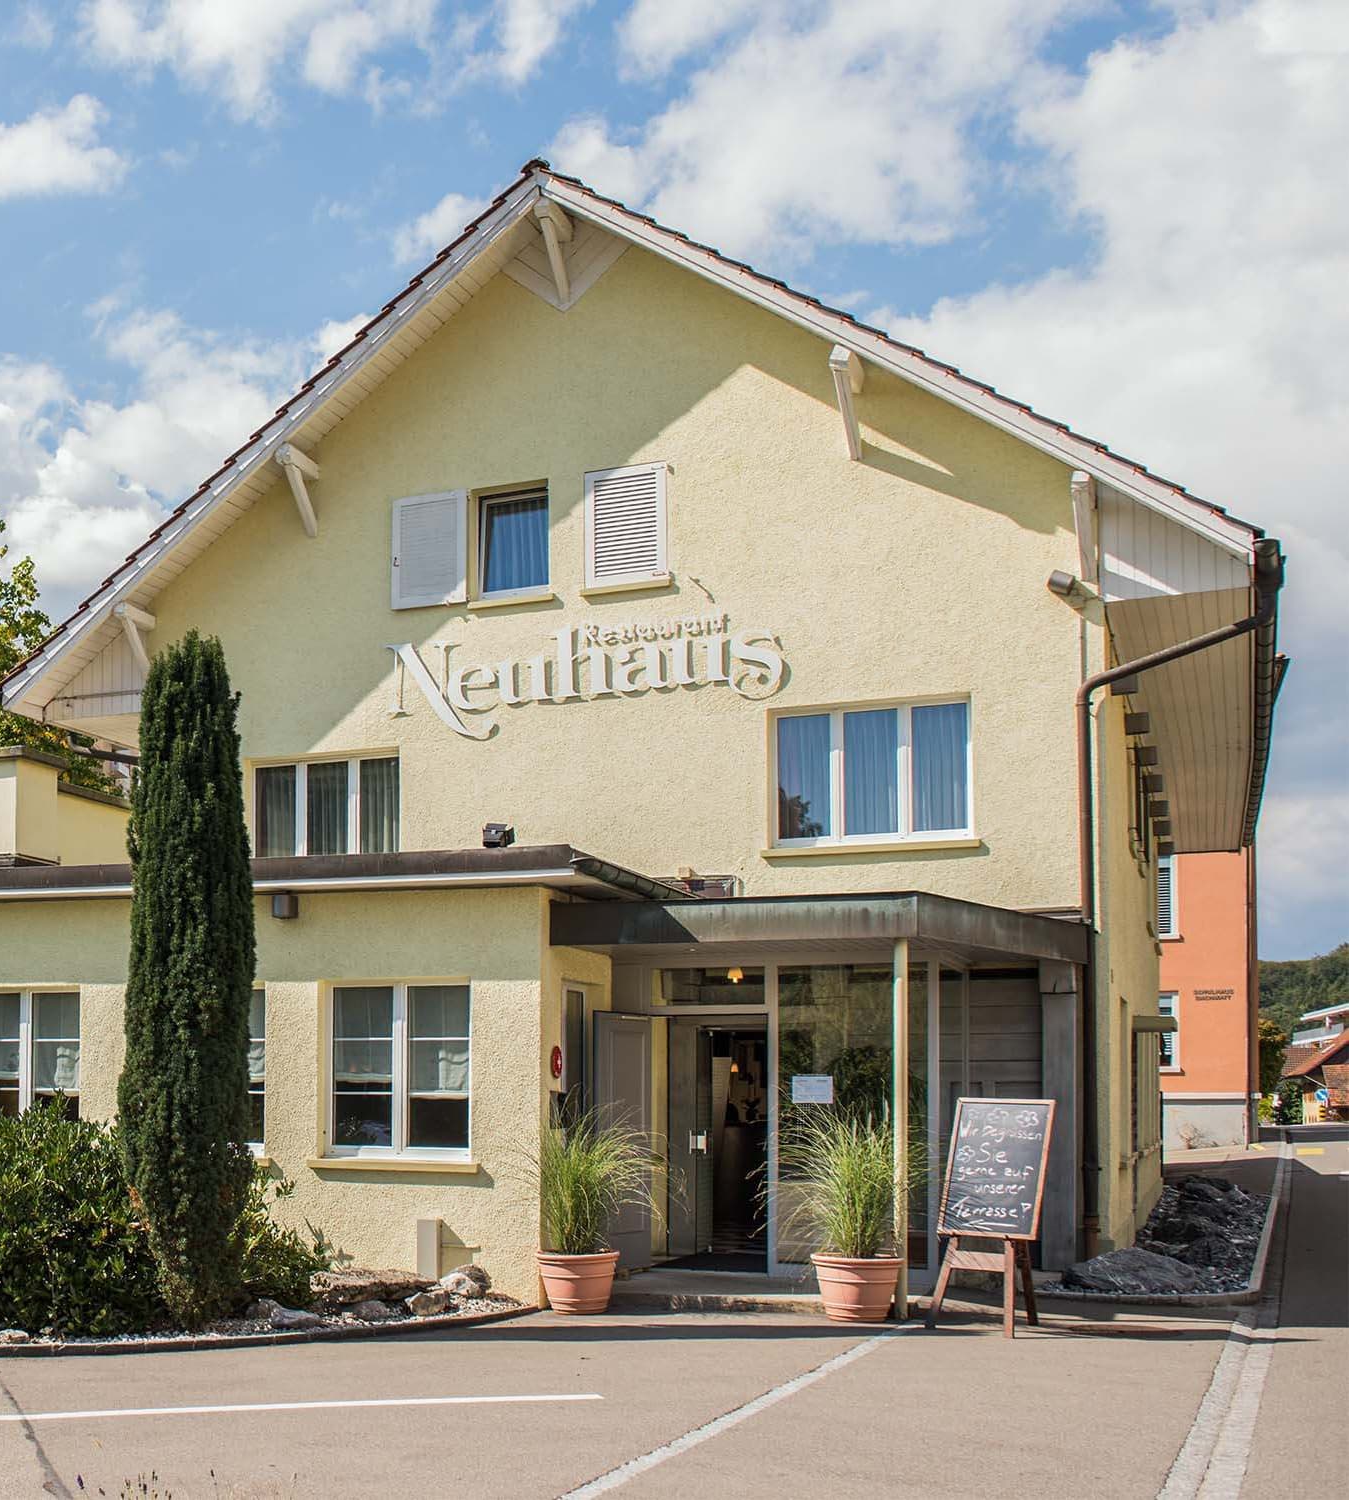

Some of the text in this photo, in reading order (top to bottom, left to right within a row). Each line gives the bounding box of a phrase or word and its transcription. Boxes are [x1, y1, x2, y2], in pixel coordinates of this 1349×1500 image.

[585, 612, 731, 648] Restaurant
[385, 622, 786, 740] Neuhaus
[959, 1119, 977, 1137] Wir
[976, 1142, 1009, 1163] Sie
[957, 1165, 1034, 1181] gerne auf
[973, 1184, 1027, 1195] unserer
